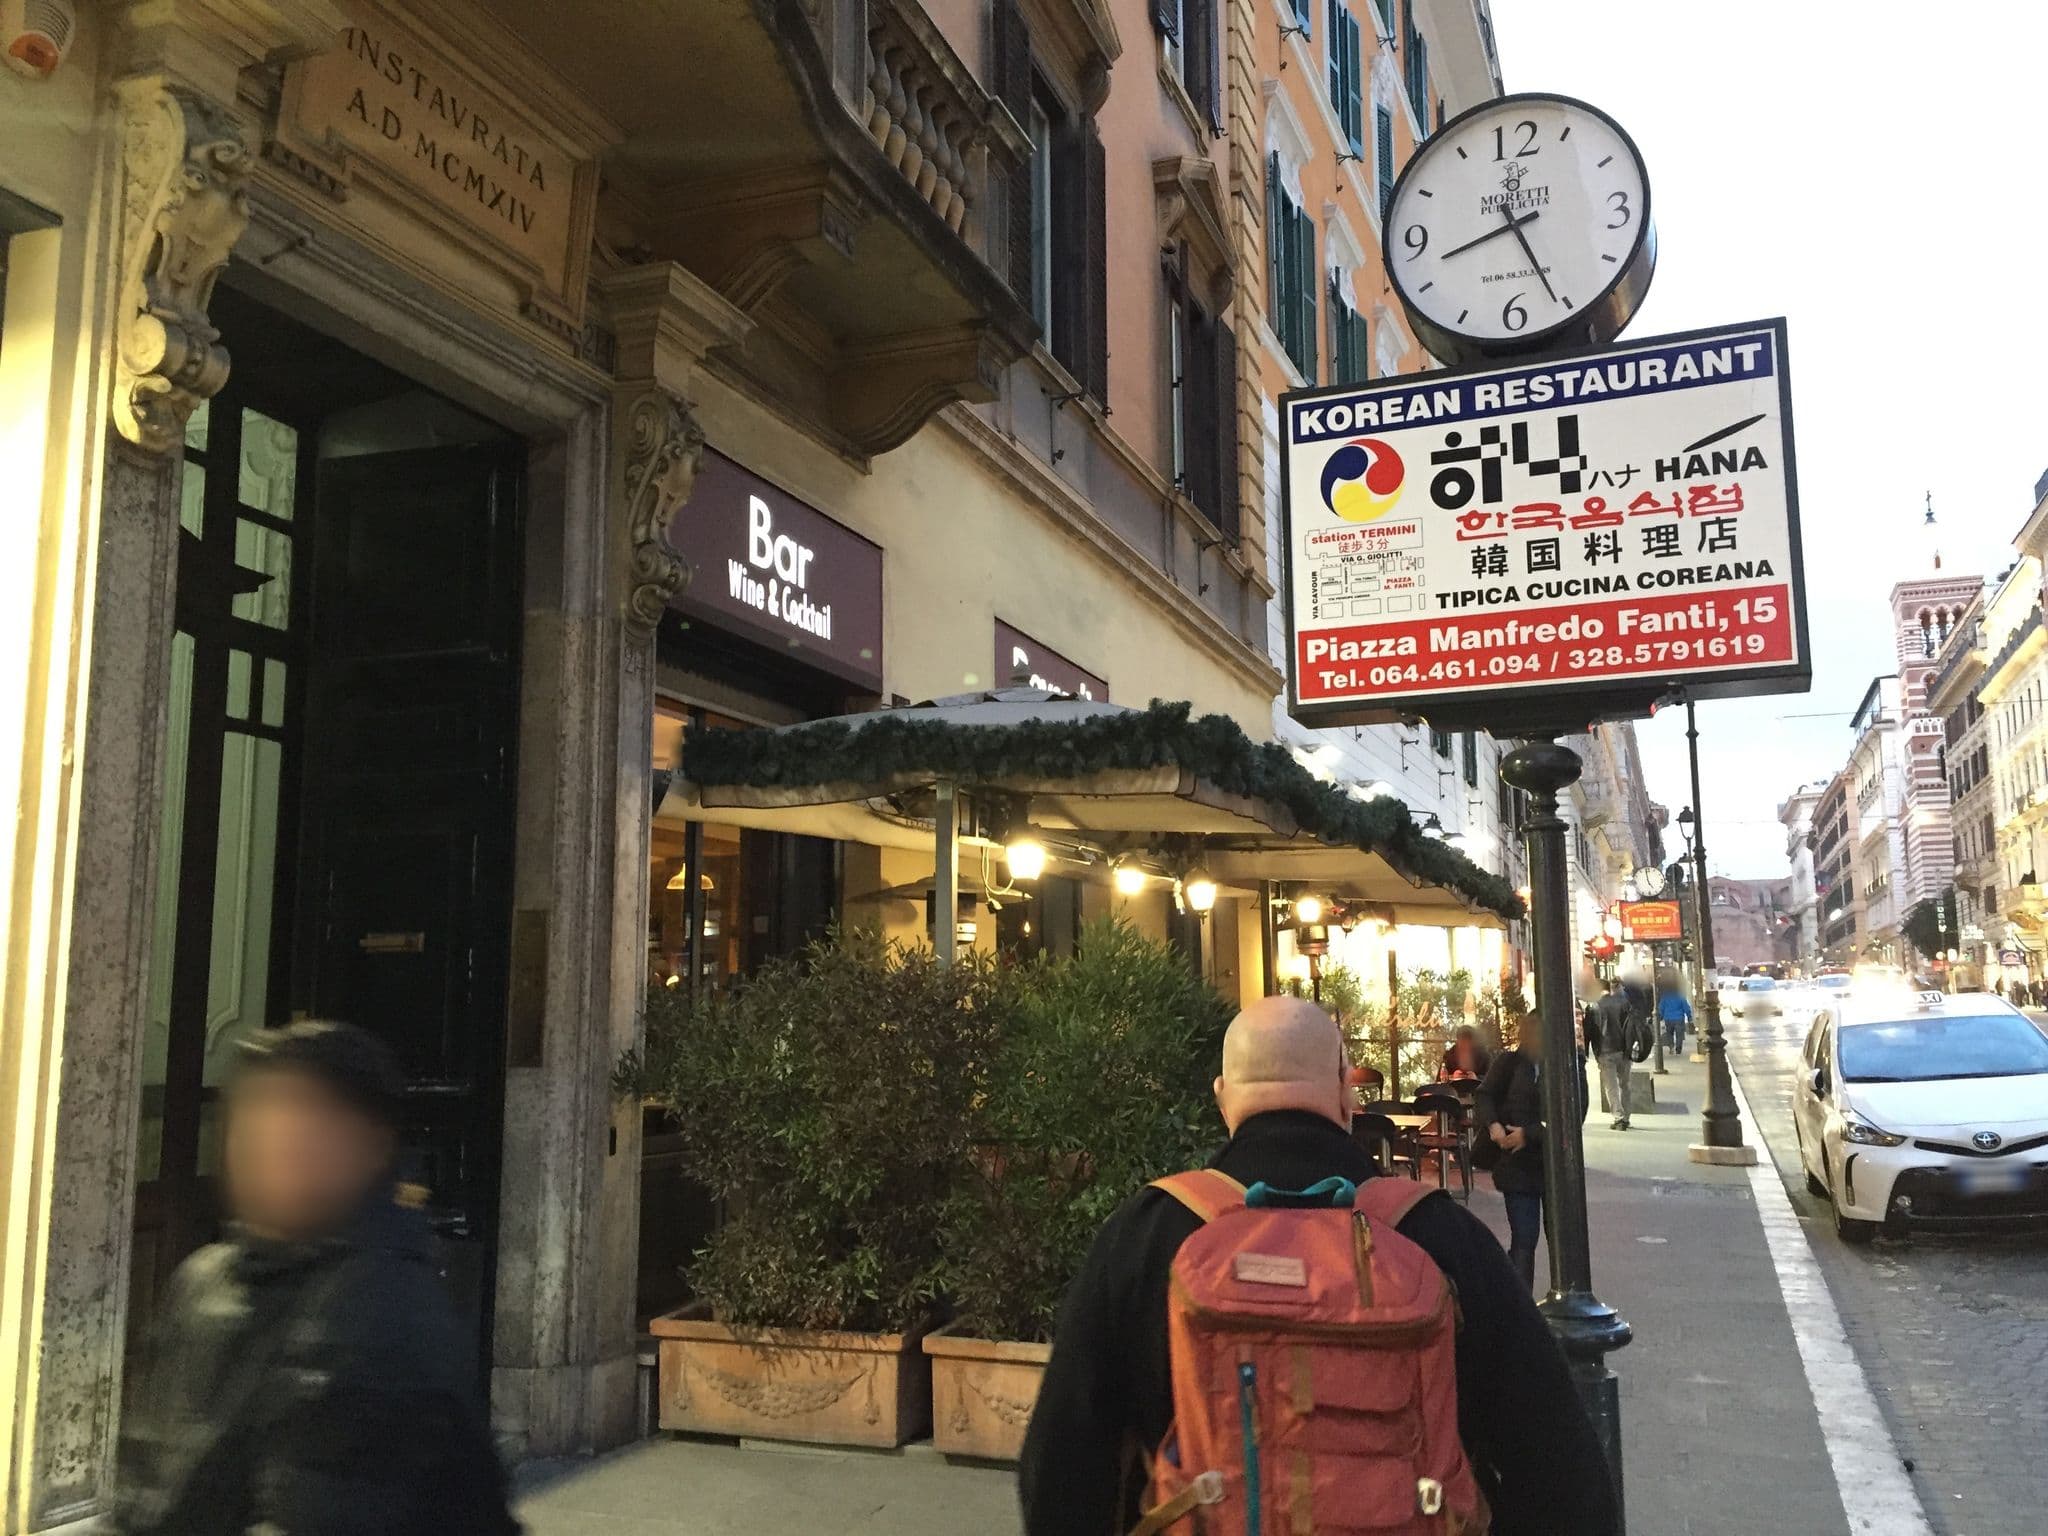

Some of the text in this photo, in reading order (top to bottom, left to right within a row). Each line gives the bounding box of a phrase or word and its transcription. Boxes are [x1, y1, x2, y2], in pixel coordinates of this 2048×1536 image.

[340, 27, 545, 192] INSTAVRATA
[1490, 120, 1541, 162] 12
[413, 132, 537, 234] MCMXIV
[1480, 186, 1550, 206] MORETTI
[1606, 191, 1631, 230] 3
[1403, 224, 1429, 262] 9
[1502, 292, 1528, 331] 6
[1299, 342, 1763, 437] KOREAN RESTAURANT
[1430, 414, 1588, 510] 하나
[1588, 463, 1641, 490] ハナ
[1654, 445, 1769, 483] HANA
[1455, 482, 1745, 542] 한국음식점
[749, 494, 814, 589] Bar
[1311, 524, 1416, 545] station TERMINI
[1367, 551, 1403, 560] GIOLITTI
[1470, 516, 1738, 579] 韓国料理店
[728, 558, 832, 641] Wine & Cocktail
[1311, 570, 1319, 604] CAVOUR
[1386, 576, 1412, 584] PIAZZA
[1394, 582, 1415, 590] FANTI
[1435, 559, 1775, 609] TIPICA CUCINA COREANA
[1306, 634, 1418, 664] Piazza
[1429, 614, 1605, 653] Manfredo
[1369, 653, 1541, 686] 064.461.094
[1568, 634, 1766, 670] 328.5791619
